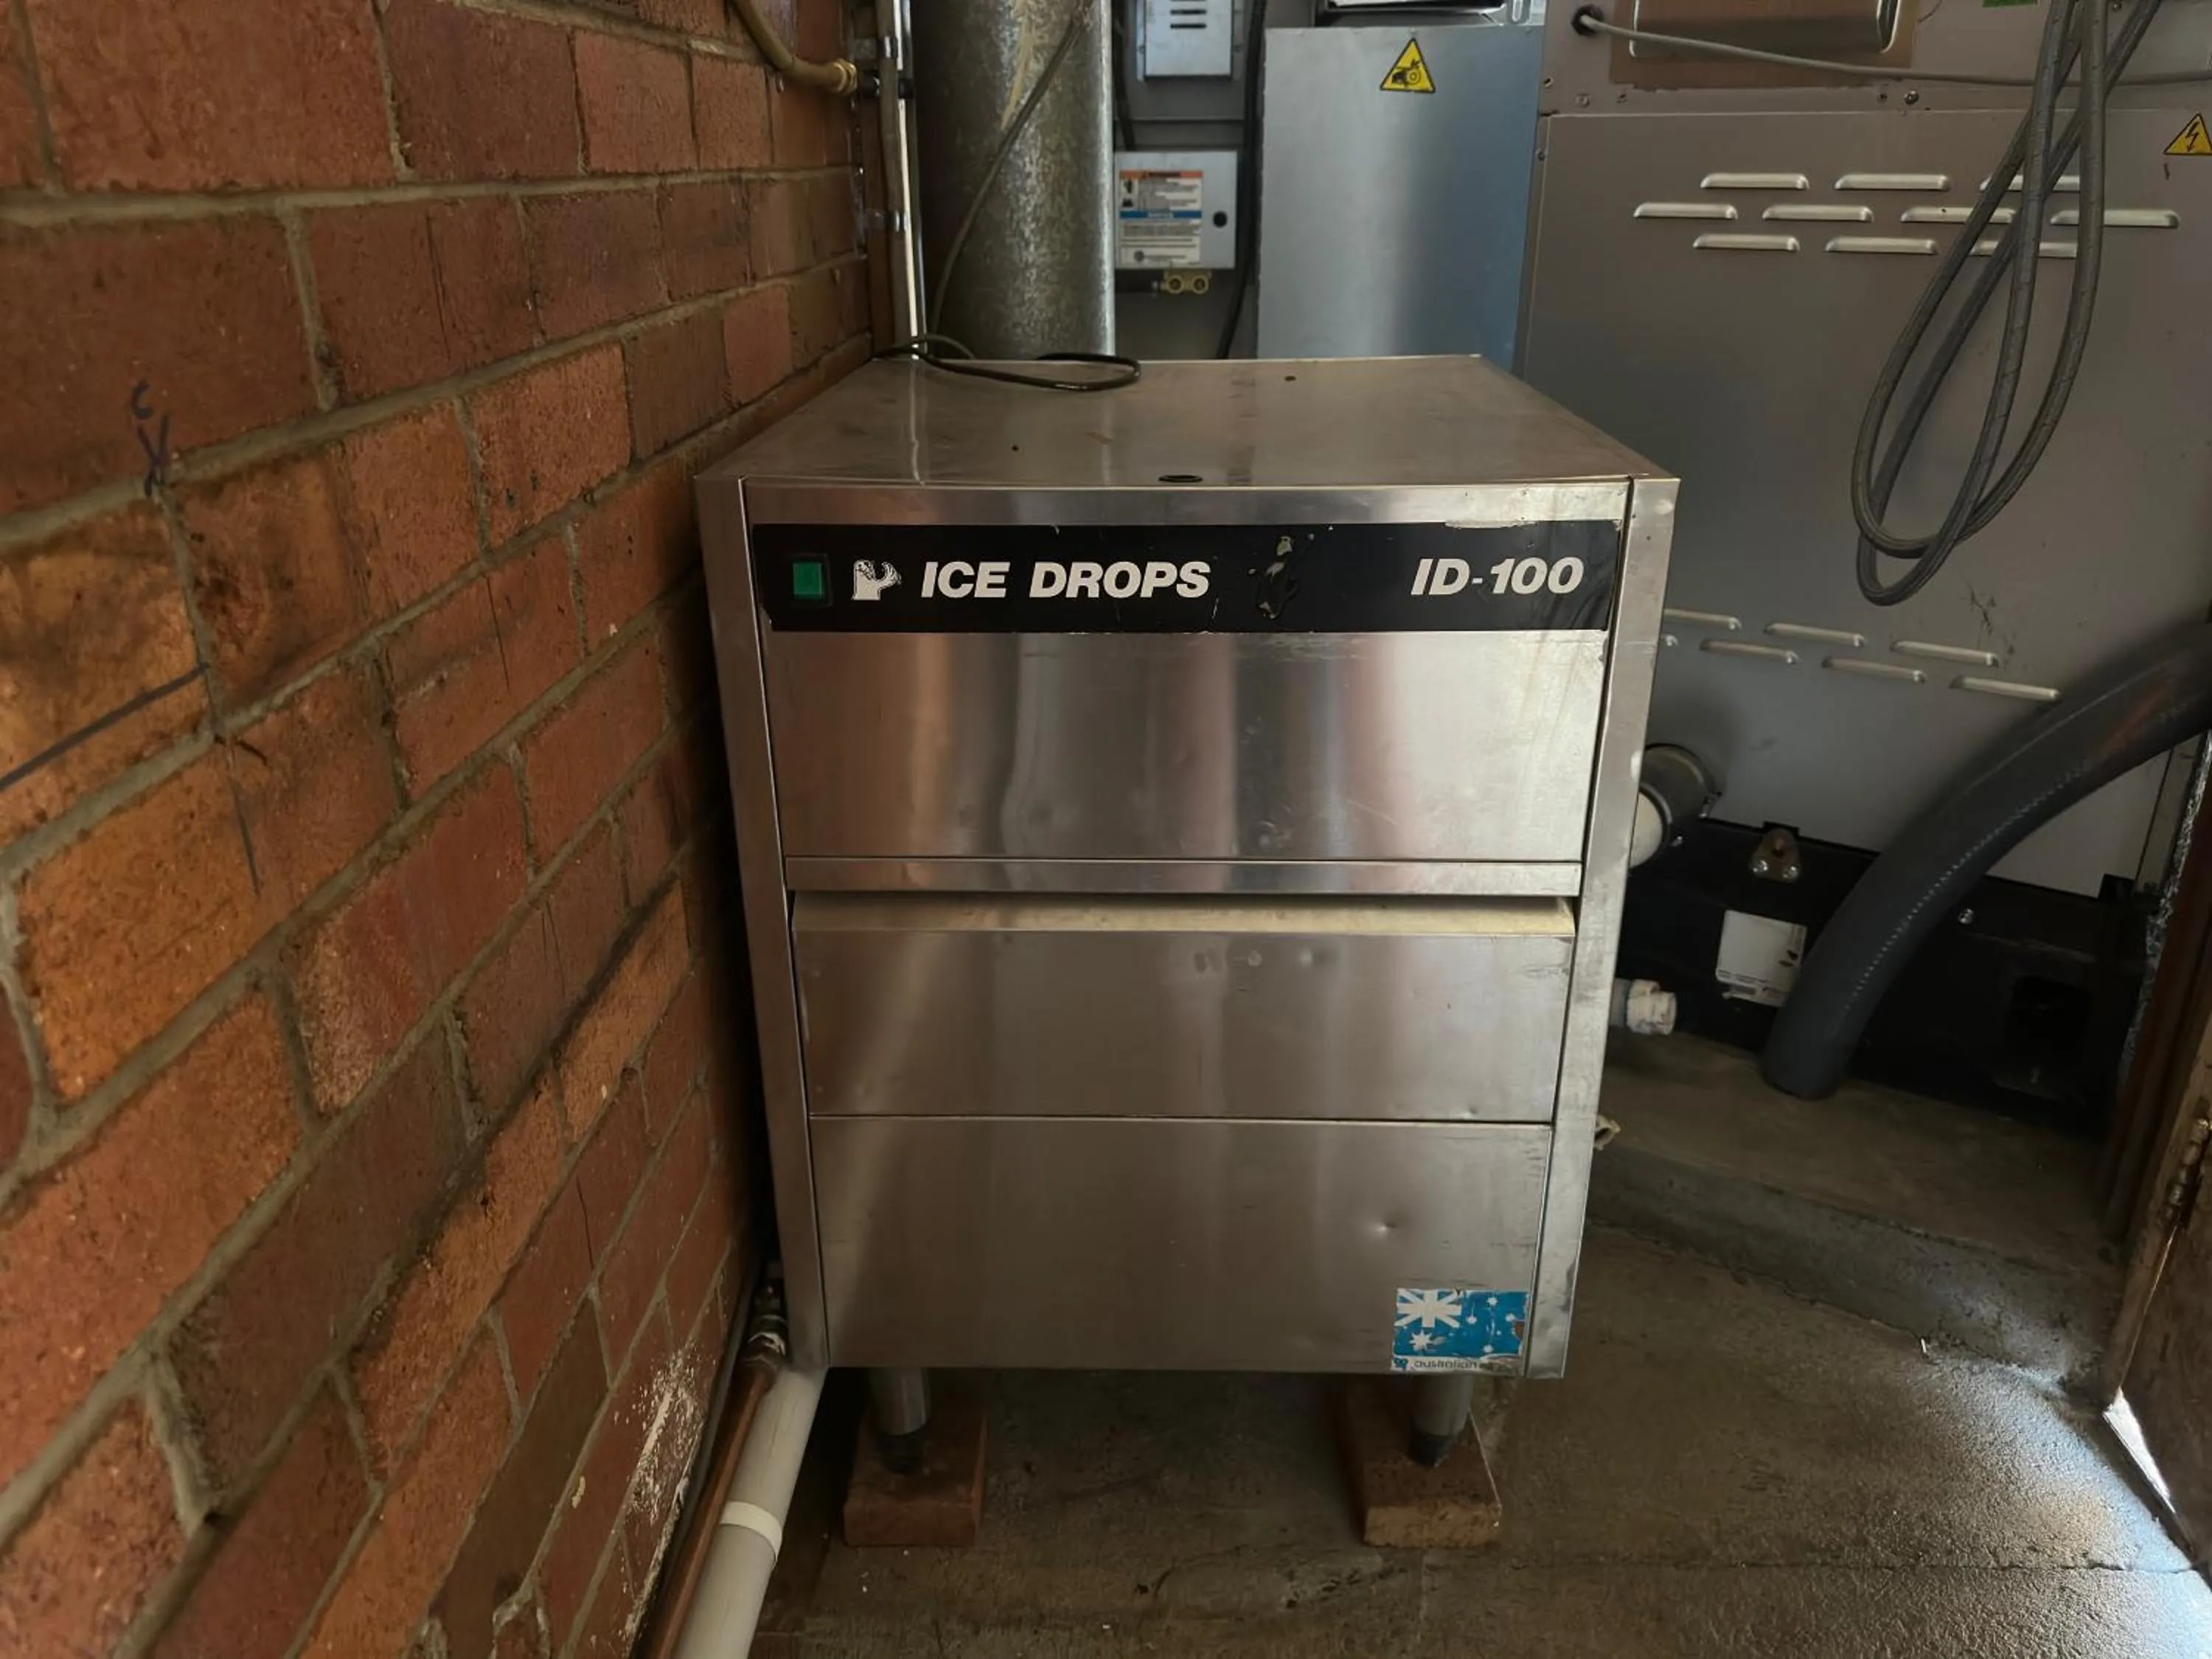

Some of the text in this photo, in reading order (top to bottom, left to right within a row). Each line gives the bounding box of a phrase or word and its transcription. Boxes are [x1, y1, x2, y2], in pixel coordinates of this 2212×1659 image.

[921, 561, 1211, 598] ICE DROPS
[1411, 557, 1585, 595] ID-100
